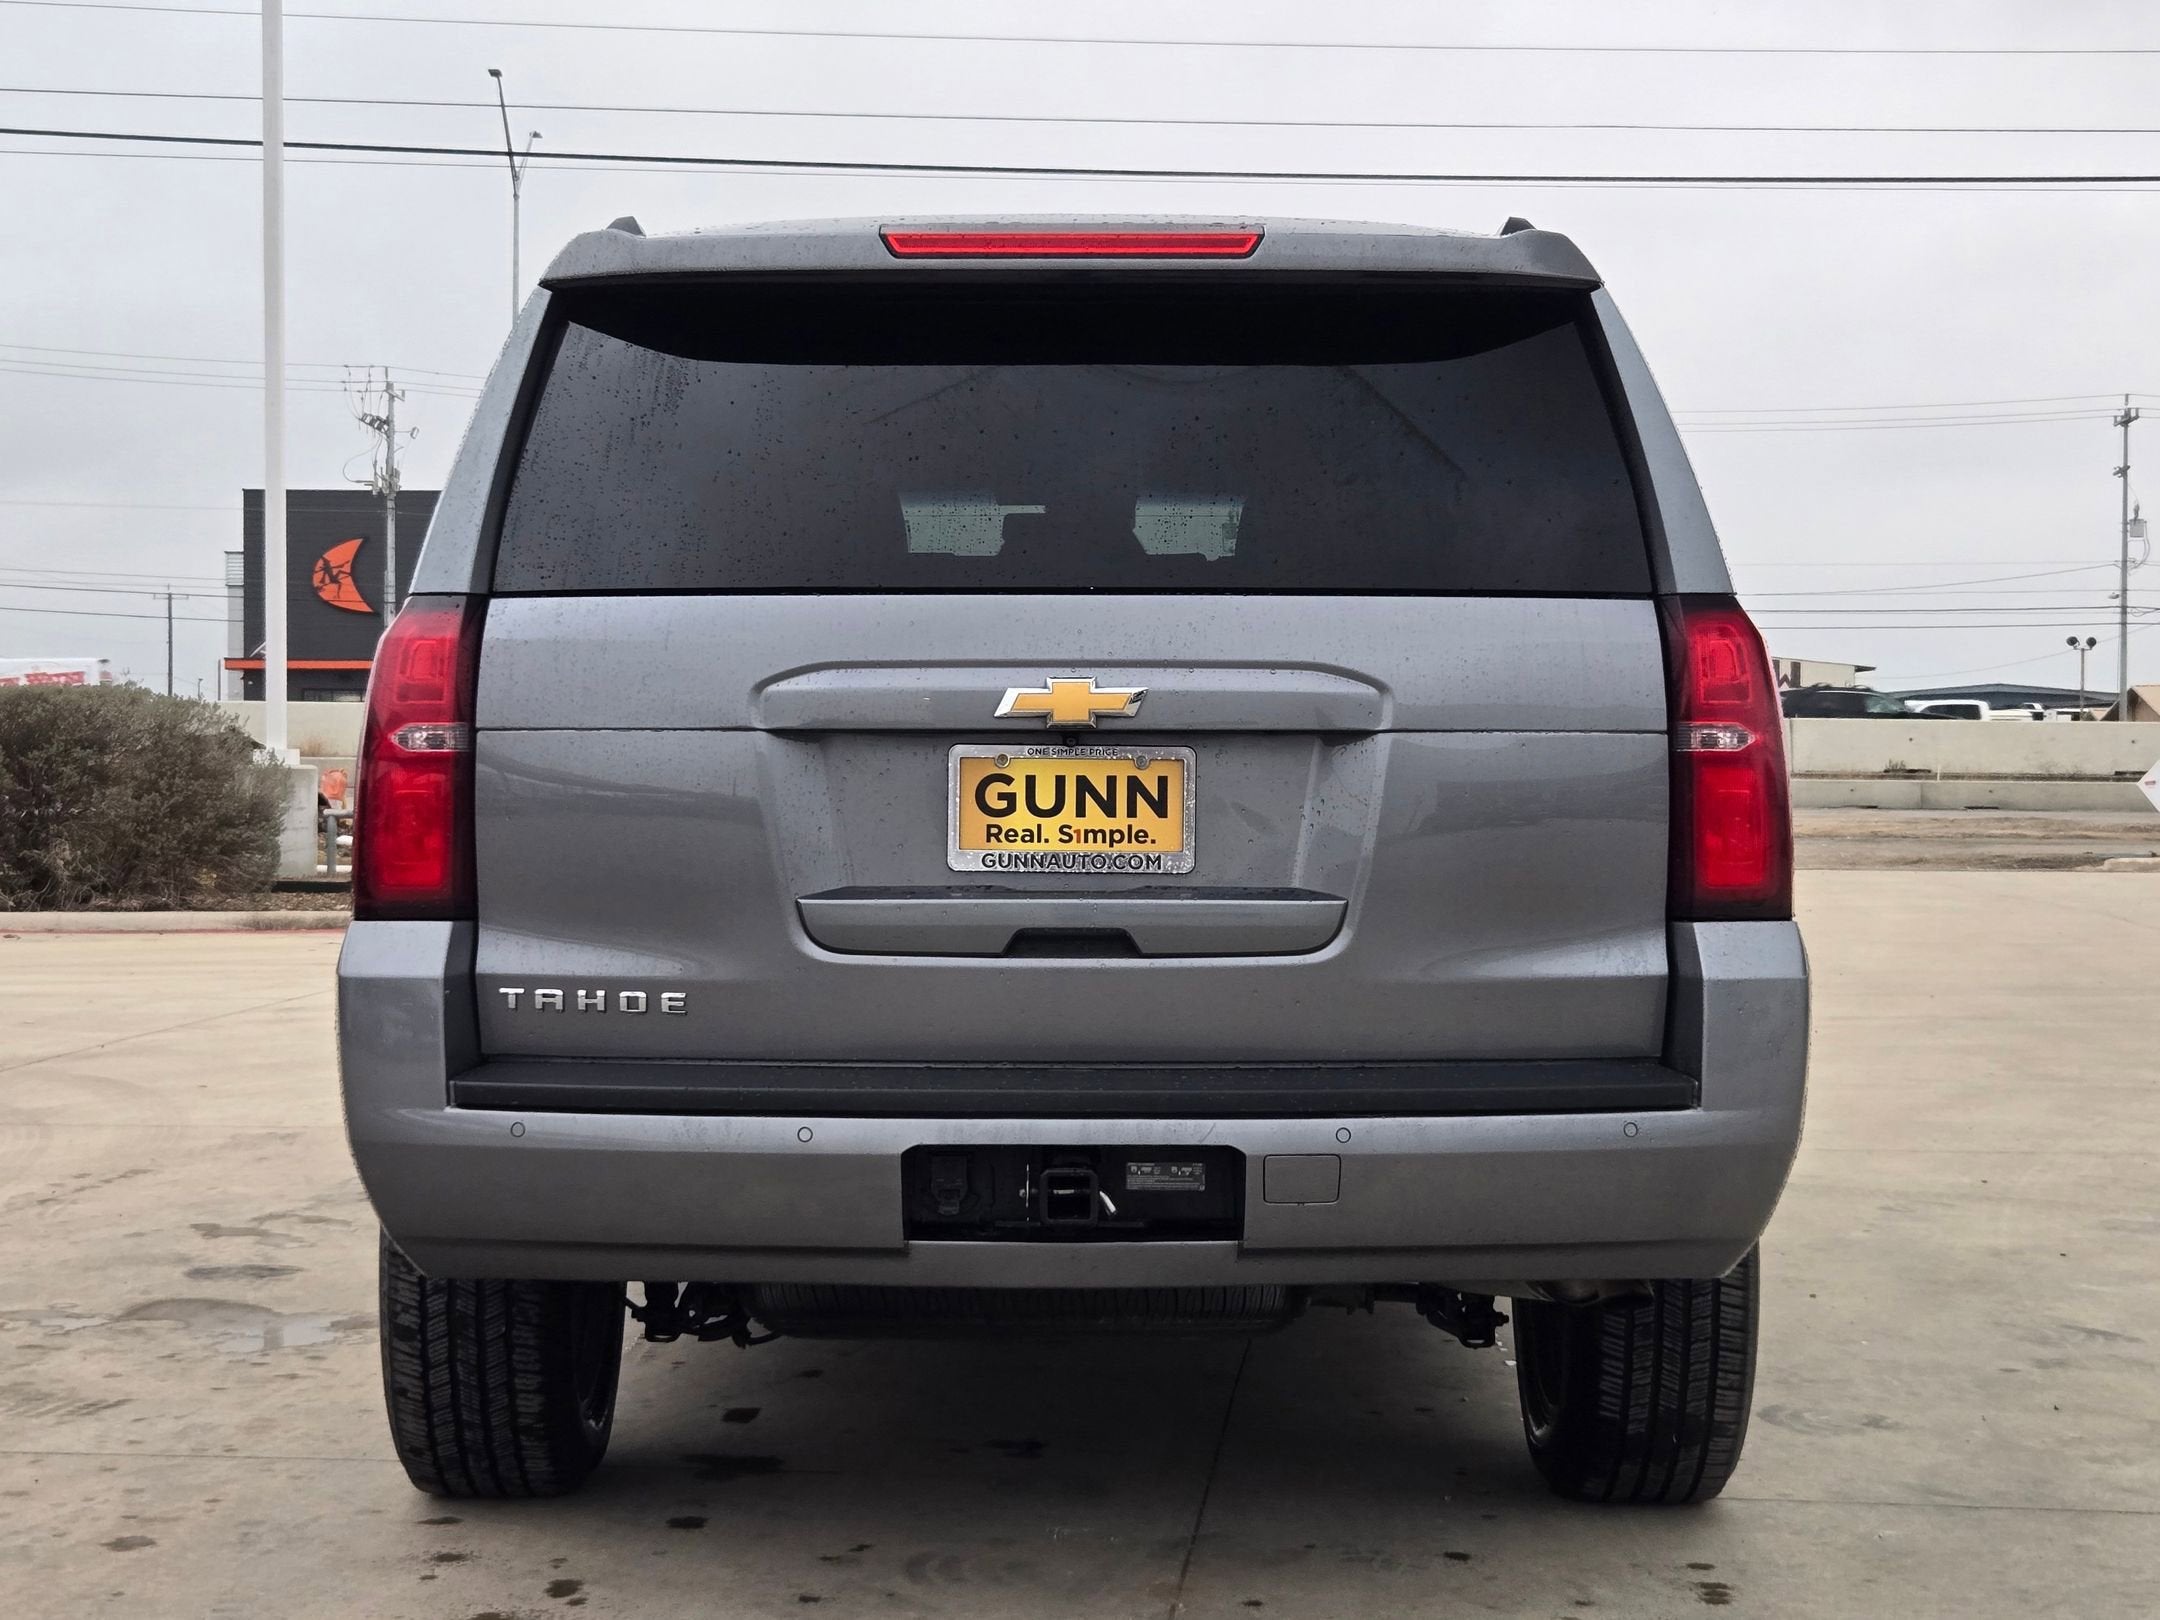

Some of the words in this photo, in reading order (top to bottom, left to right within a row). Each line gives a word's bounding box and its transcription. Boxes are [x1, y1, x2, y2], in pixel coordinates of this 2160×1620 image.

[1027, 747, 1049, 756] ONE
[1051, 747, 1086, 756] SIMPLE
[1089, 748, 1118, 756] PRICE
[974, 773, 1169, 819] GUNN
[985, 824, 1049, 844] Real.
[981, 853, 1162, 870] GUNNAUTO.COM
[499, 987, 688, 1014] TAHOE
